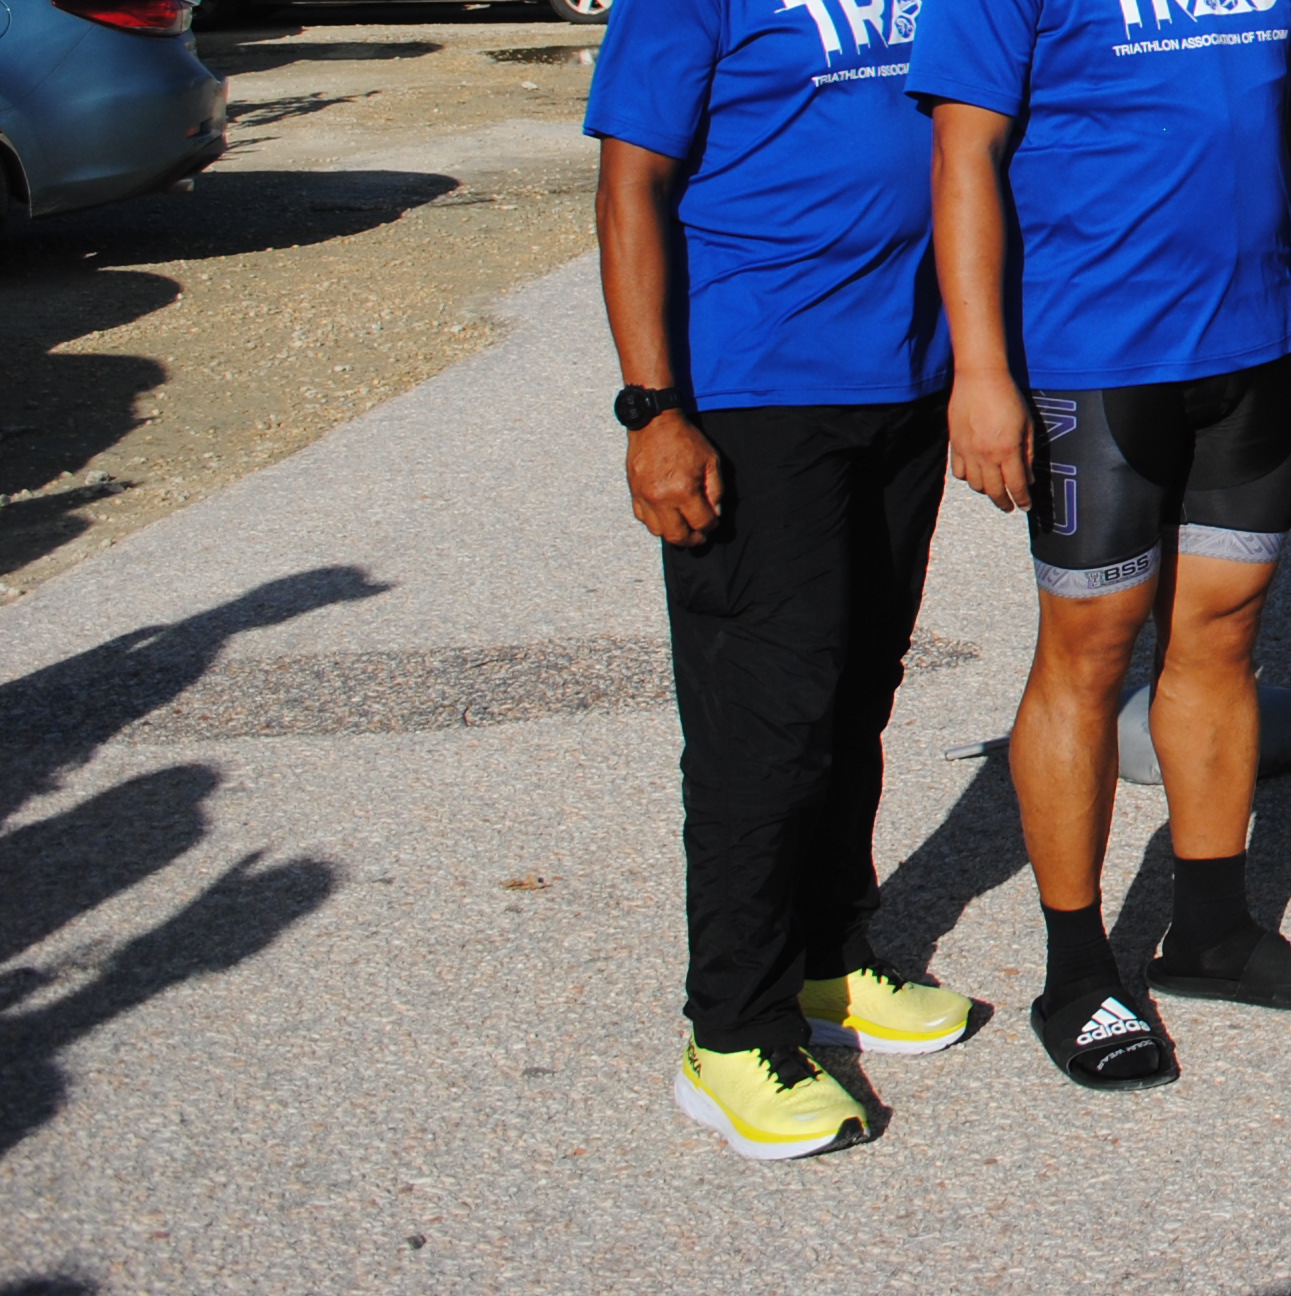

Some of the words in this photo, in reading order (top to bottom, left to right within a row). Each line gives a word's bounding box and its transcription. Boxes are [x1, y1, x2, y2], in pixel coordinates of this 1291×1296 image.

[1112, 39, 1180, 57] TRIATHLON
[1241, 31, 1255, 44] OF
[1255, 29, 1274, 41] THE
[811, 66, 876, 88] TRIATHLON
[1104, 555, 1149, 582] BSS
[1076, 1019, 1151, 1045] adidas
